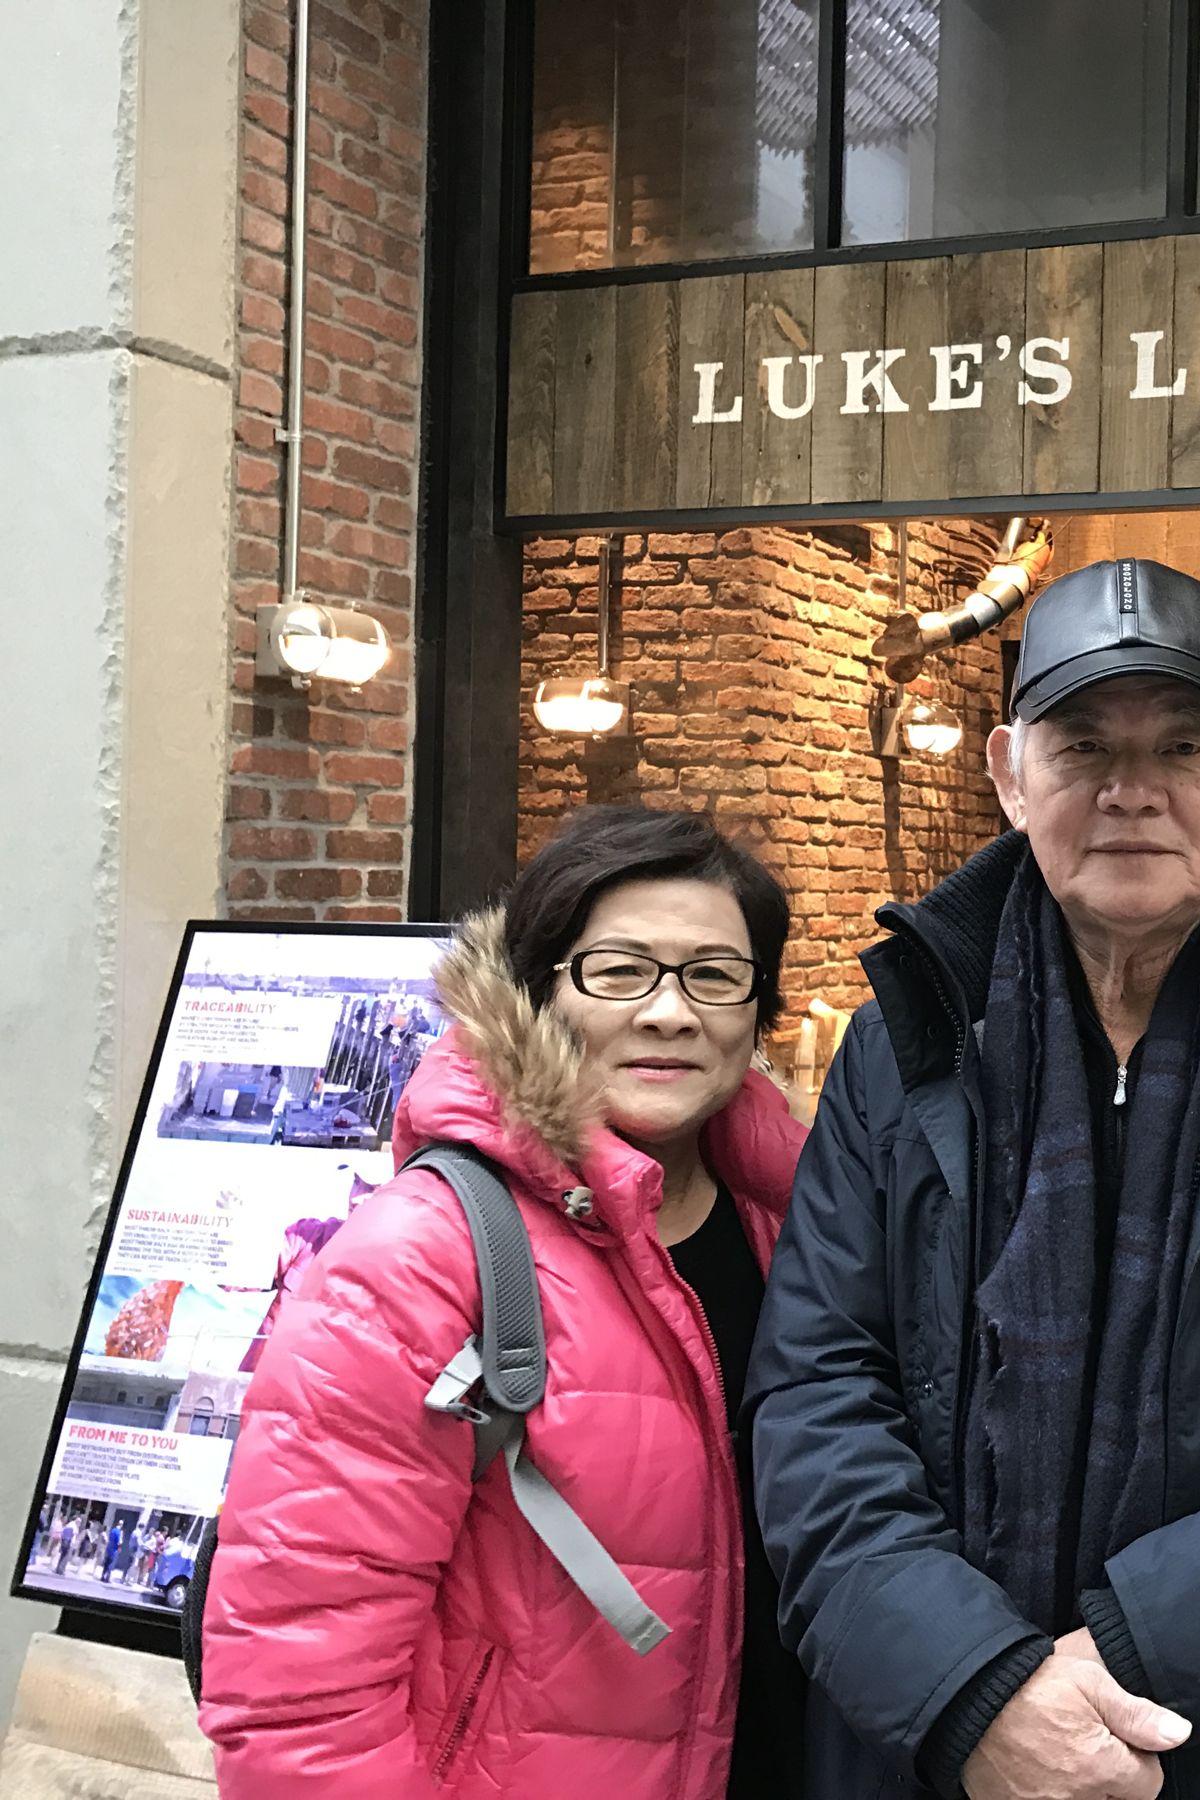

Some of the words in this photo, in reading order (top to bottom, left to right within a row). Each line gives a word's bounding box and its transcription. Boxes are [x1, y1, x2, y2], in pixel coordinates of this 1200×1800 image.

[691, 333, 1073, 425] LUKE'S
[184, 1000, 276, 1014] TRACEABILITY
[127, 1208, 233, 1228] SUSTAINABILITY
[69, 1424, 106, 1441] FROM
[108, 1431, 127, 1444] ME
[131, 1433, 149, 1446] TO
[151, 1436, 179, 1451] YOU
